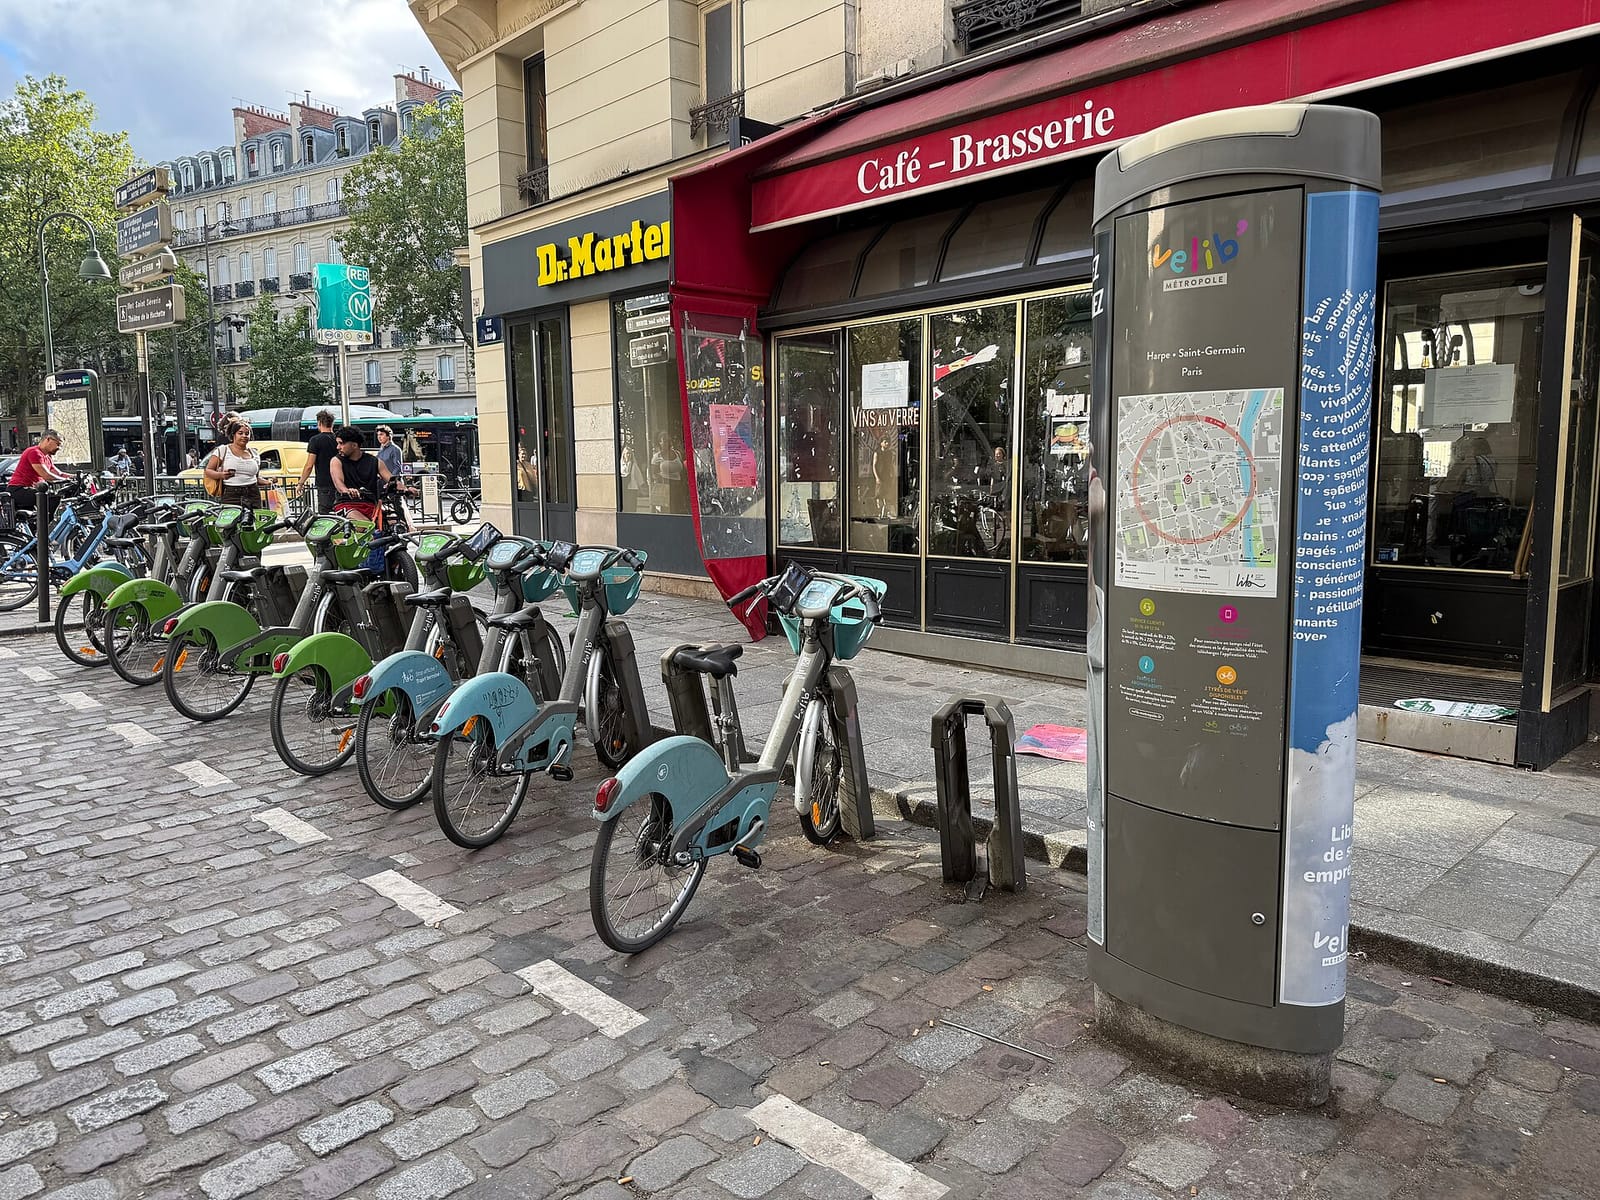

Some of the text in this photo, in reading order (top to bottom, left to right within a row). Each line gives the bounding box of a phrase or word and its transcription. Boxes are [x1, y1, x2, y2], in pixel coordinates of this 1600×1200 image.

[857, 146, 922, 195] Café
[949, 99, 1116, 174] Brasserie
[350, 268, 368, 281] RER
[1164, 275, 1225, 290] MÉTROPOLE
[354, 297, 369, 315] M
[1325, 288, 1354, 331] sportif
[1338, 290, 1369, 339] engagés
[1146, 344, 1246, 363] Harpe Saint-Germain
[1181, 367, 1203, 377] Paris
[1320, 383, 1362, 409] vivants
[851, 405, 920, 428] VINS AU VERRE
[1295, 556, 1357, 570] conscients
[1315, 569, 1362, 587] généreux
[1323, 847, 1344, 863] de
